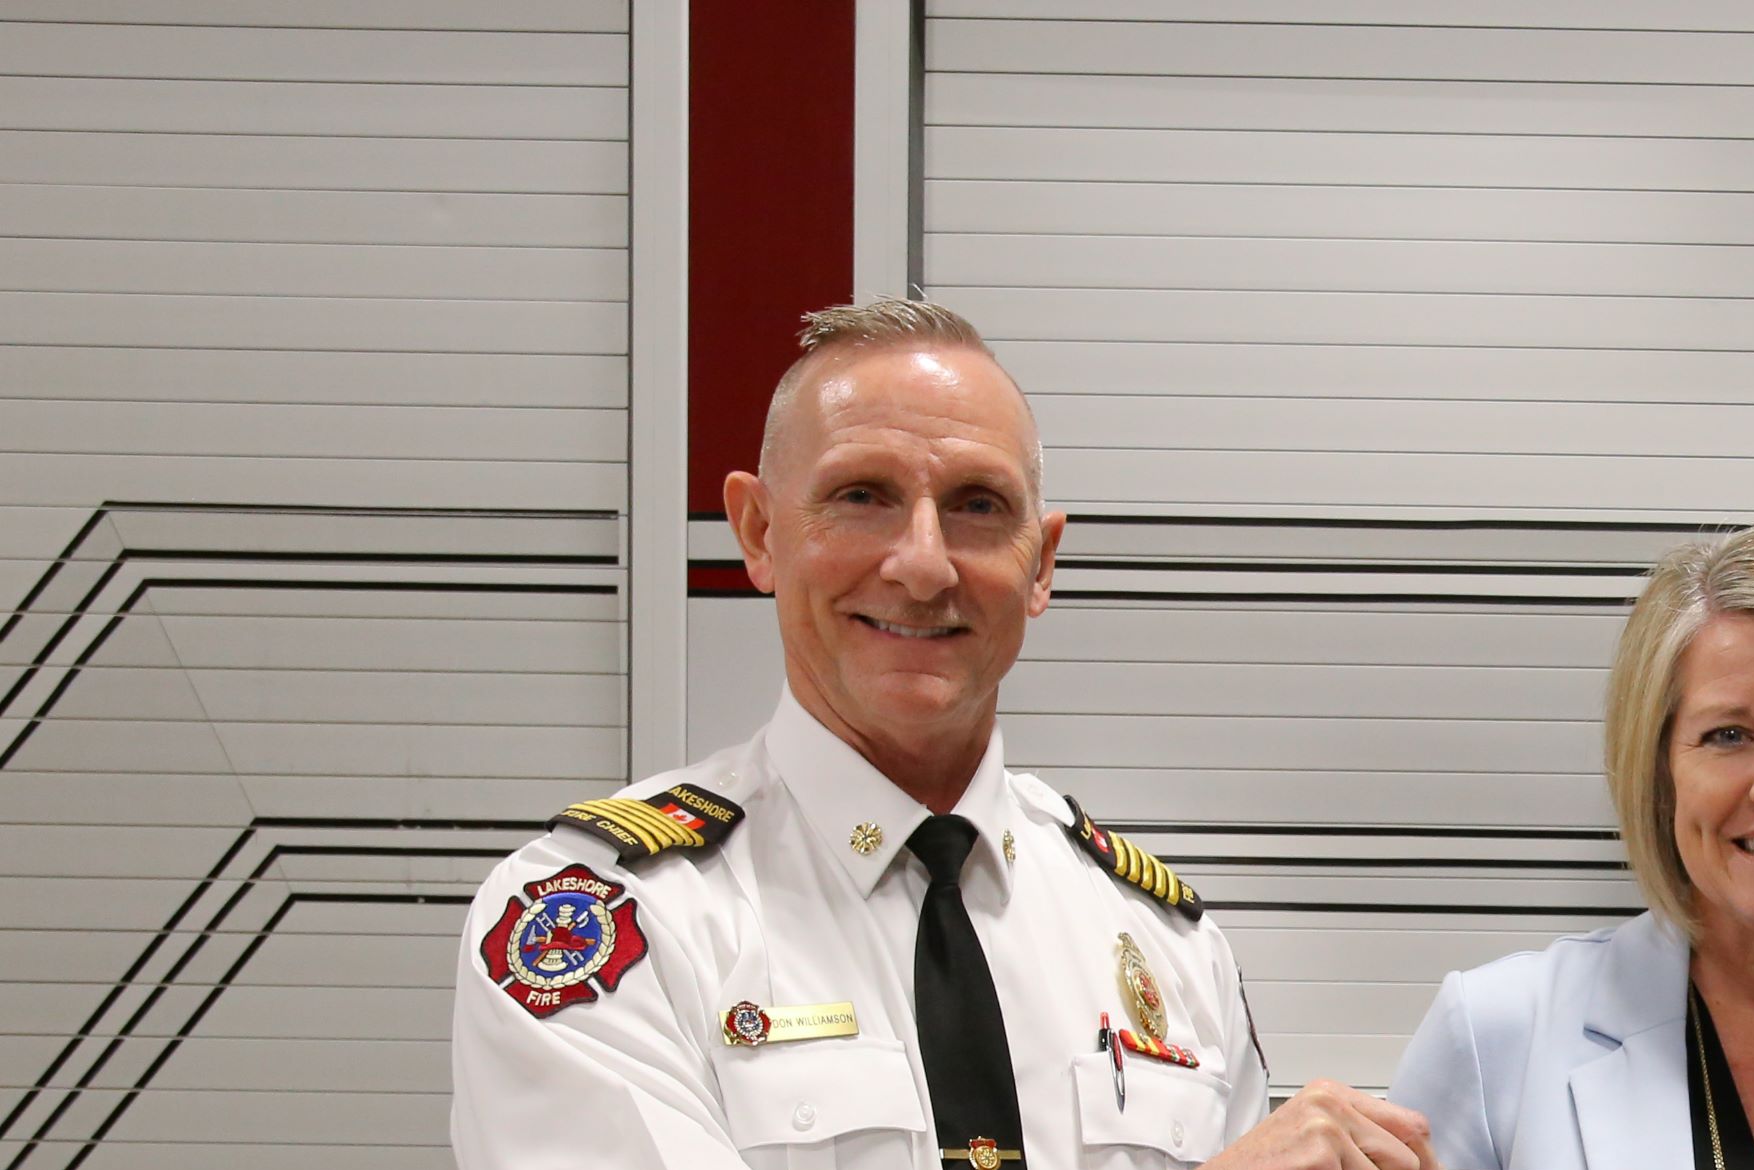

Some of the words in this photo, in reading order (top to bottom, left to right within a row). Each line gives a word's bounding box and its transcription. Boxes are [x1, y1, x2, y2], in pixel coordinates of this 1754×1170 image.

[669, 786, 735, 823] AKESHORE
[561, 810, 597, 822] FIRE
[596, 820, 639, 845] CHIEF
[537, 877, 611, 898] LAKESHORE
[526, 991, 561, 1006] FIRE
[796, 1013, 854, 1027] WILLIAMSON
